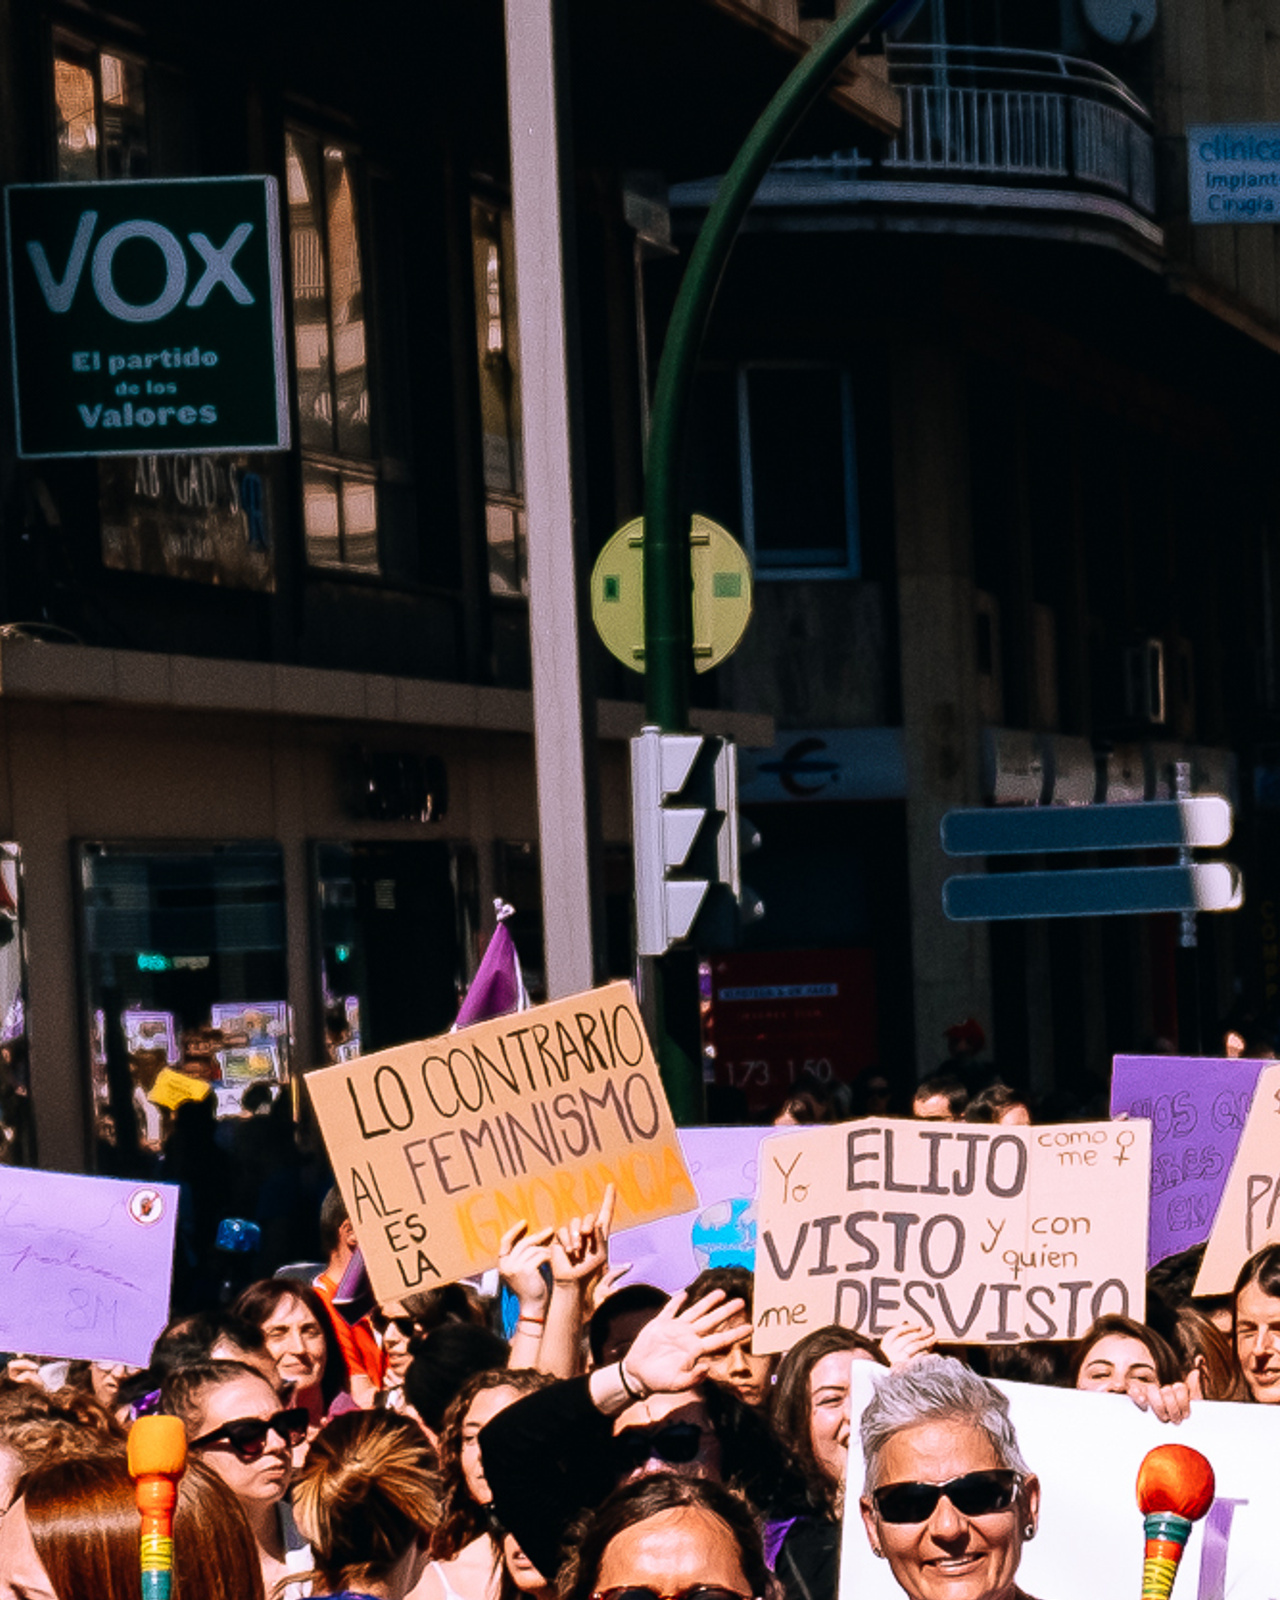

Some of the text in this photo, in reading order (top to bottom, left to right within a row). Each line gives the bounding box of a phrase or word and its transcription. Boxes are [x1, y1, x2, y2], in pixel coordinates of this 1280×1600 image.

[26, 209, 255, 322] VOX
[72, 347, 219, 376] El partido
[115, 380, 177, 396] de los
[77, 402, 218, 429] Valores
[347, 1004, 644, 1140] LO CONTRARIO
[350, 1072, 659, 1224] AL FEMINISMO
[773, 1151, 811, 1204] Yo
[847, 1127, 1028, 1198] ELIJO
[1037, 1130, 1107, 1148] como
[1056, 1149, 1097, 1166] me
[385, 1213, 427, 1252] ES
[397, 1249, 441, 1288] LA
[454, 1146, 697, 1261] IGNORANCIA
[763, 1210, 1091, 1281] VISTO y con
[1002, 1243, 1078, 1280] quien
[757, 1276, 1130, 1340] me DESVISTO
